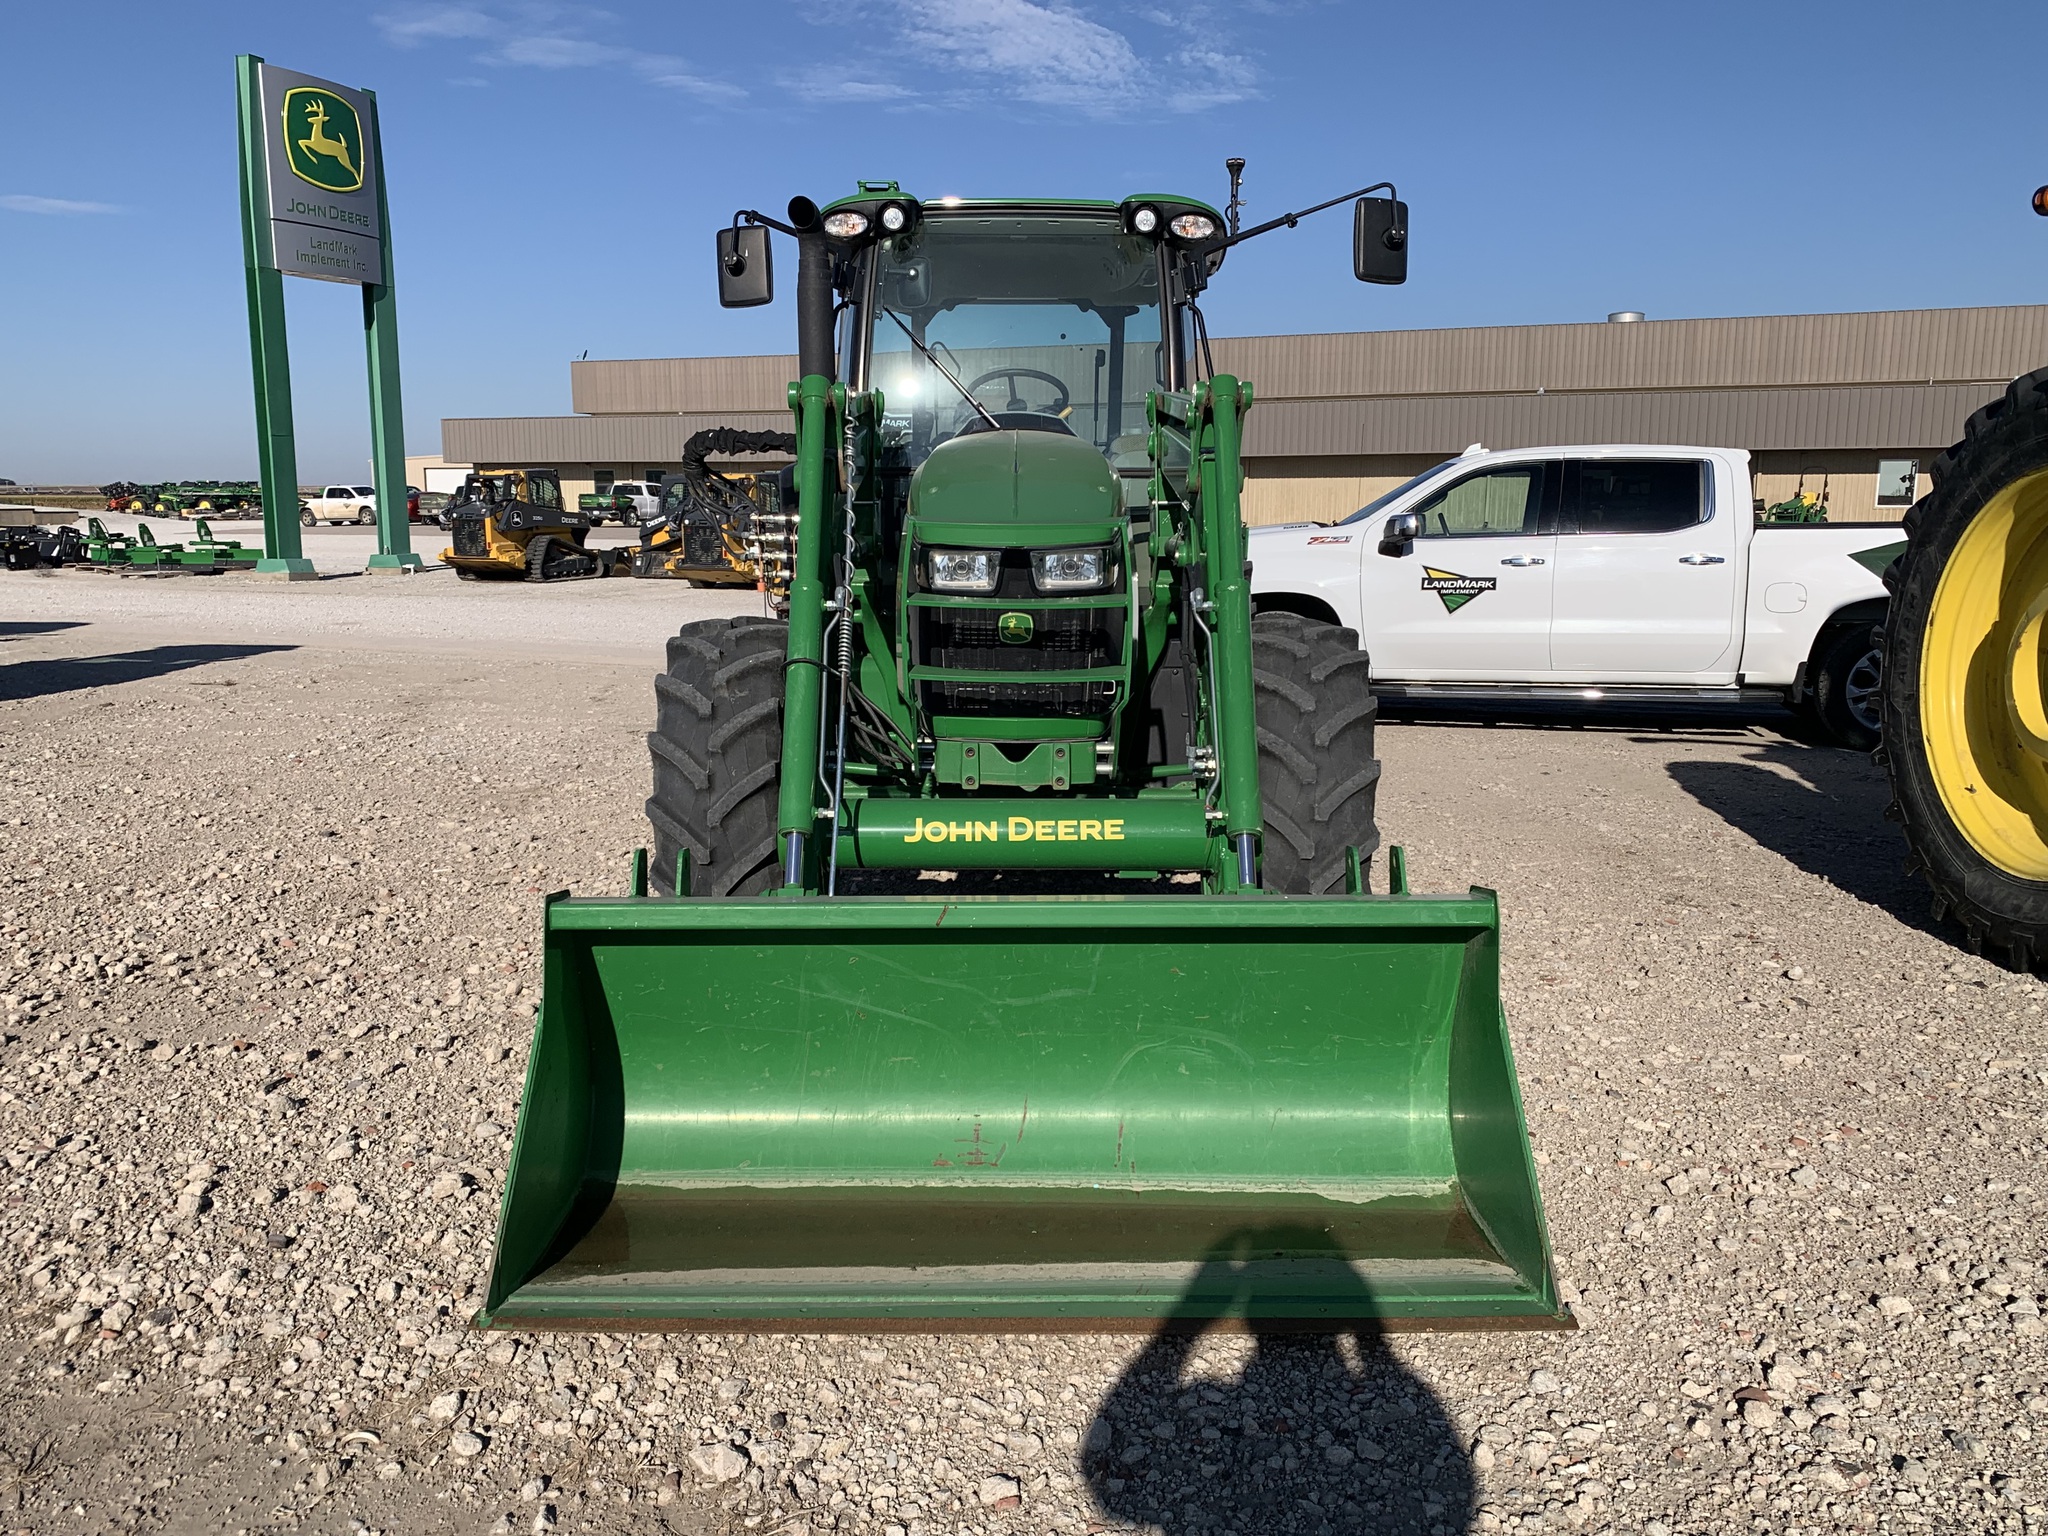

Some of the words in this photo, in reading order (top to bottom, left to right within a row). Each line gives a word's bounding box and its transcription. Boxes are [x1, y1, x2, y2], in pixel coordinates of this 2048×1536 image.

[287, 198, 326, 218] JOHN
[329, 205, 370, 228] DEERE
[310, 236, 357, 256] LandMark
[296, 249, 350, 269] Implement
[353, 258, 369, 272] Inc.
[561, 516, 579, 524] DEERE
[1423, 579, 1494, 588] LANDMARK
[904, 817, 998, 842] JOHN
[1008, 816, 1125, 841] DEERE
